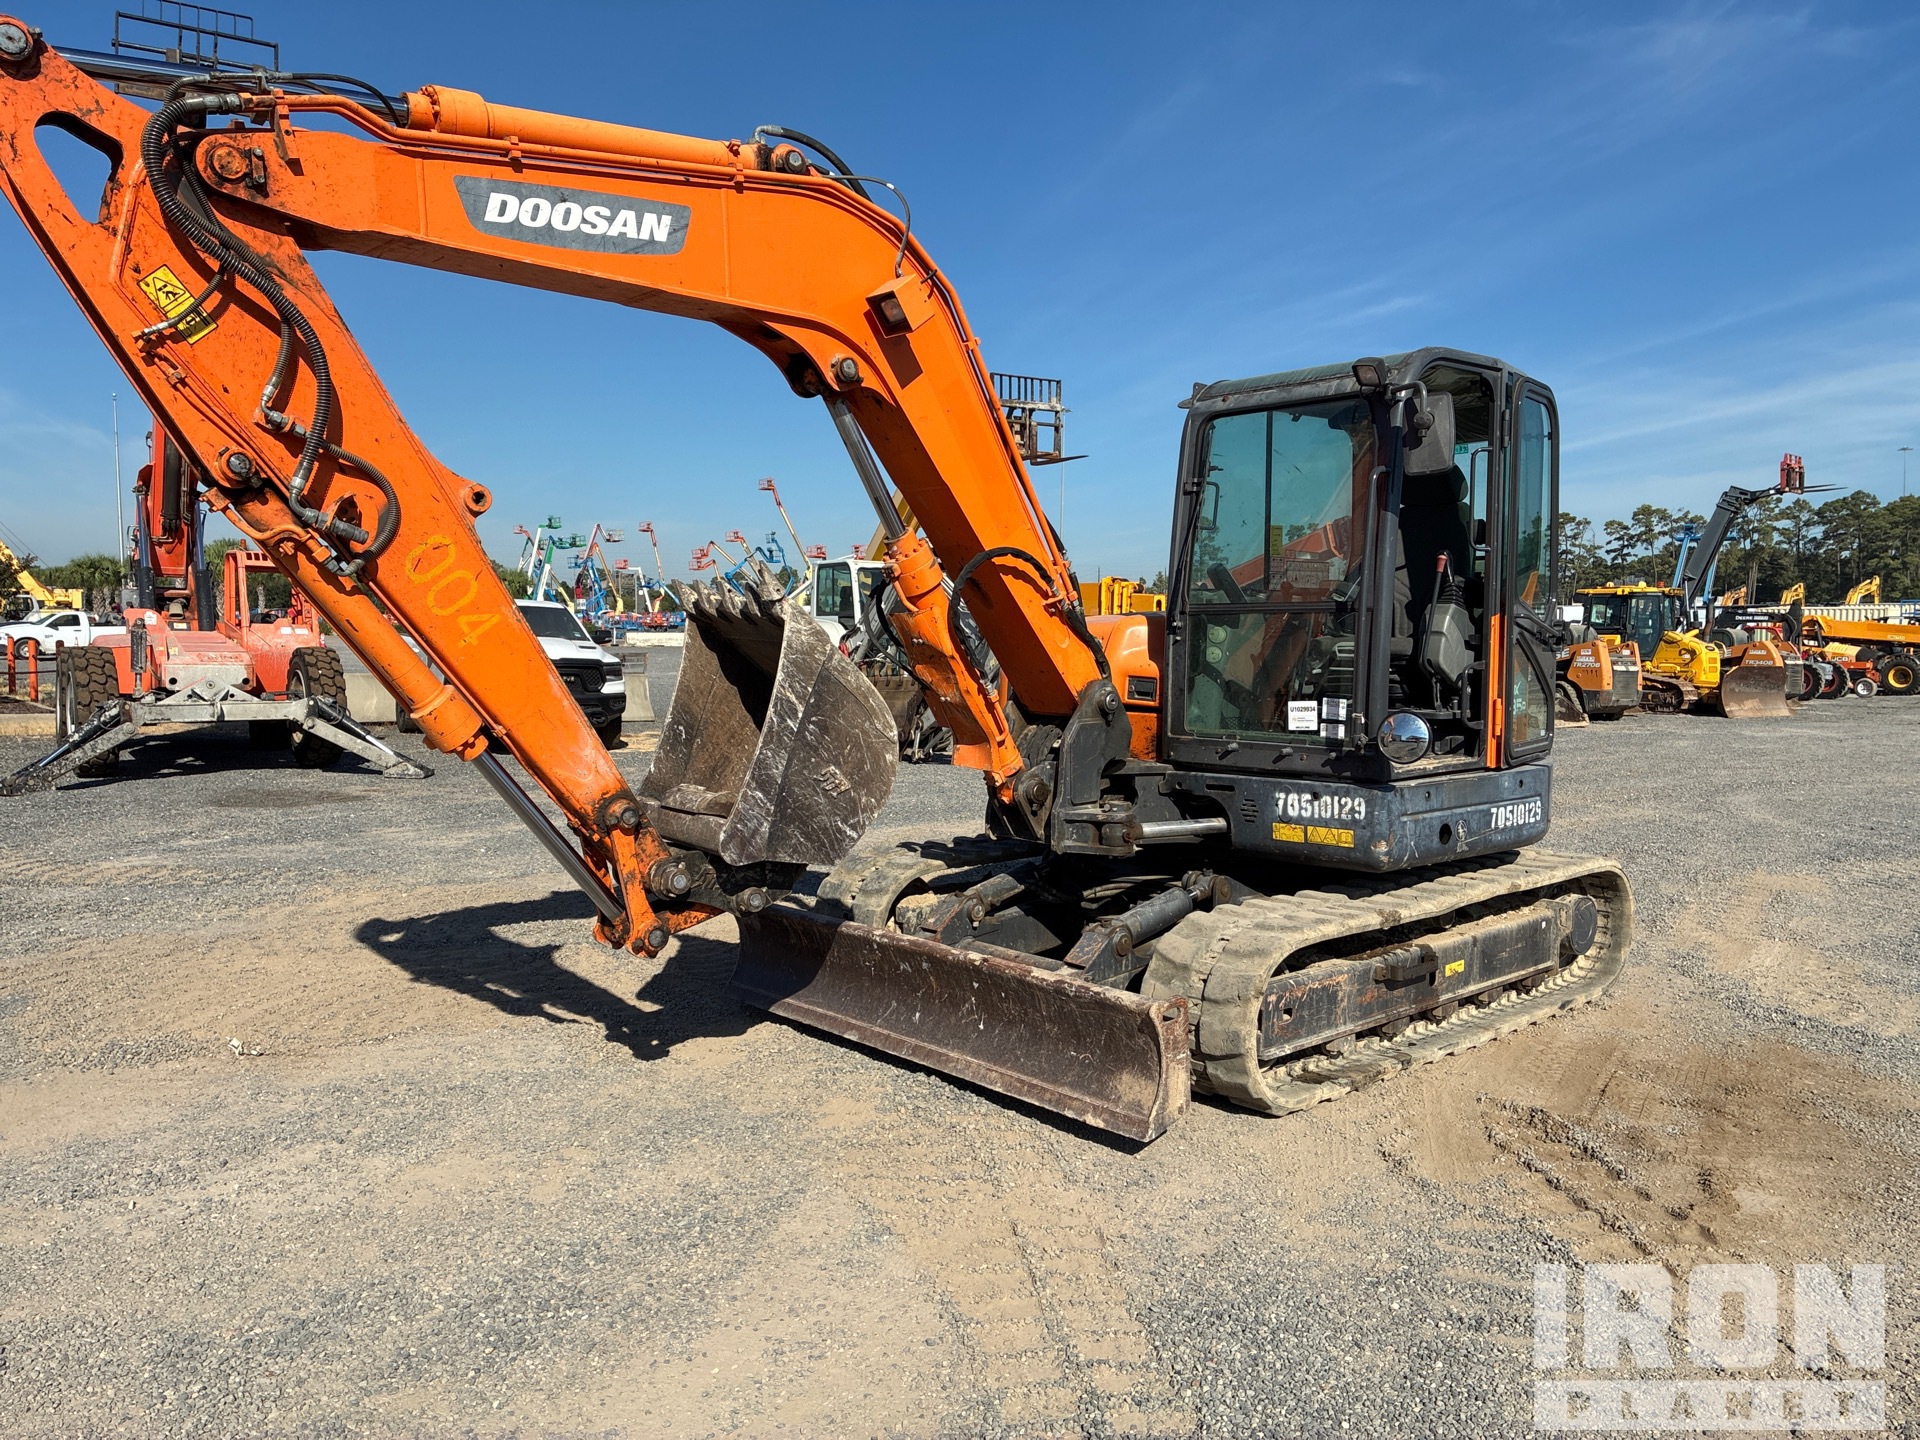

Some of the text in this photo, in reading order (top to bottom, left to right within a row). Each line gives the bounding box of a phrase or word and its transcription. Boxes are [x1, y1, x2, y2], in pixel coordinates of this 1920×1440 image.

[483, 191, 673, 243] DOOSAN
[404, 533, 502, 649] 004
[1490, 800, 1542, 830] 70510129
